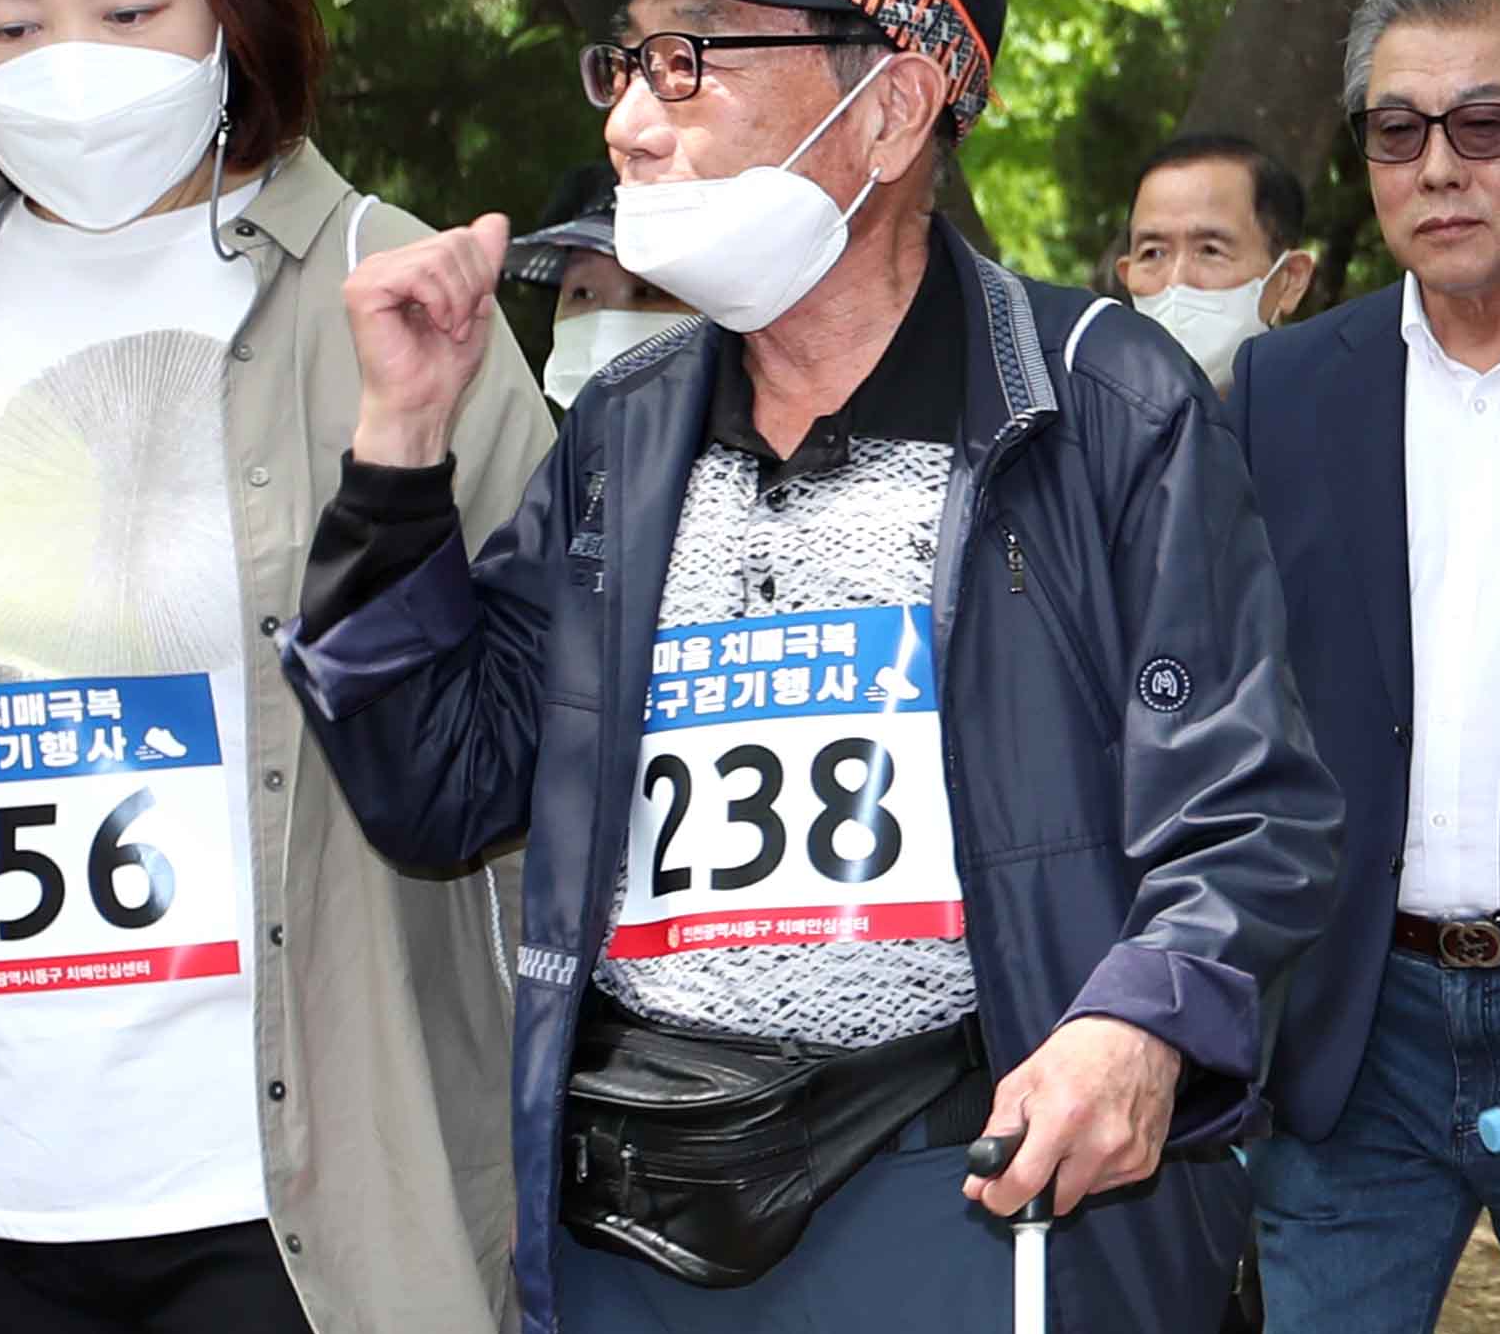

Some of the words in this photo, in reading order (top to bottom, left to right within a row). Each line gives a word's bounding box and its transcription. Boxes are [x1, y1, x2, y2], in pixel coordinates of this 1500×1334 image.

[719, 622, 858, 666] 치매극복
[643, 664, 859, 721] 구걷기행사
[643, 737, 902, 899] 238
